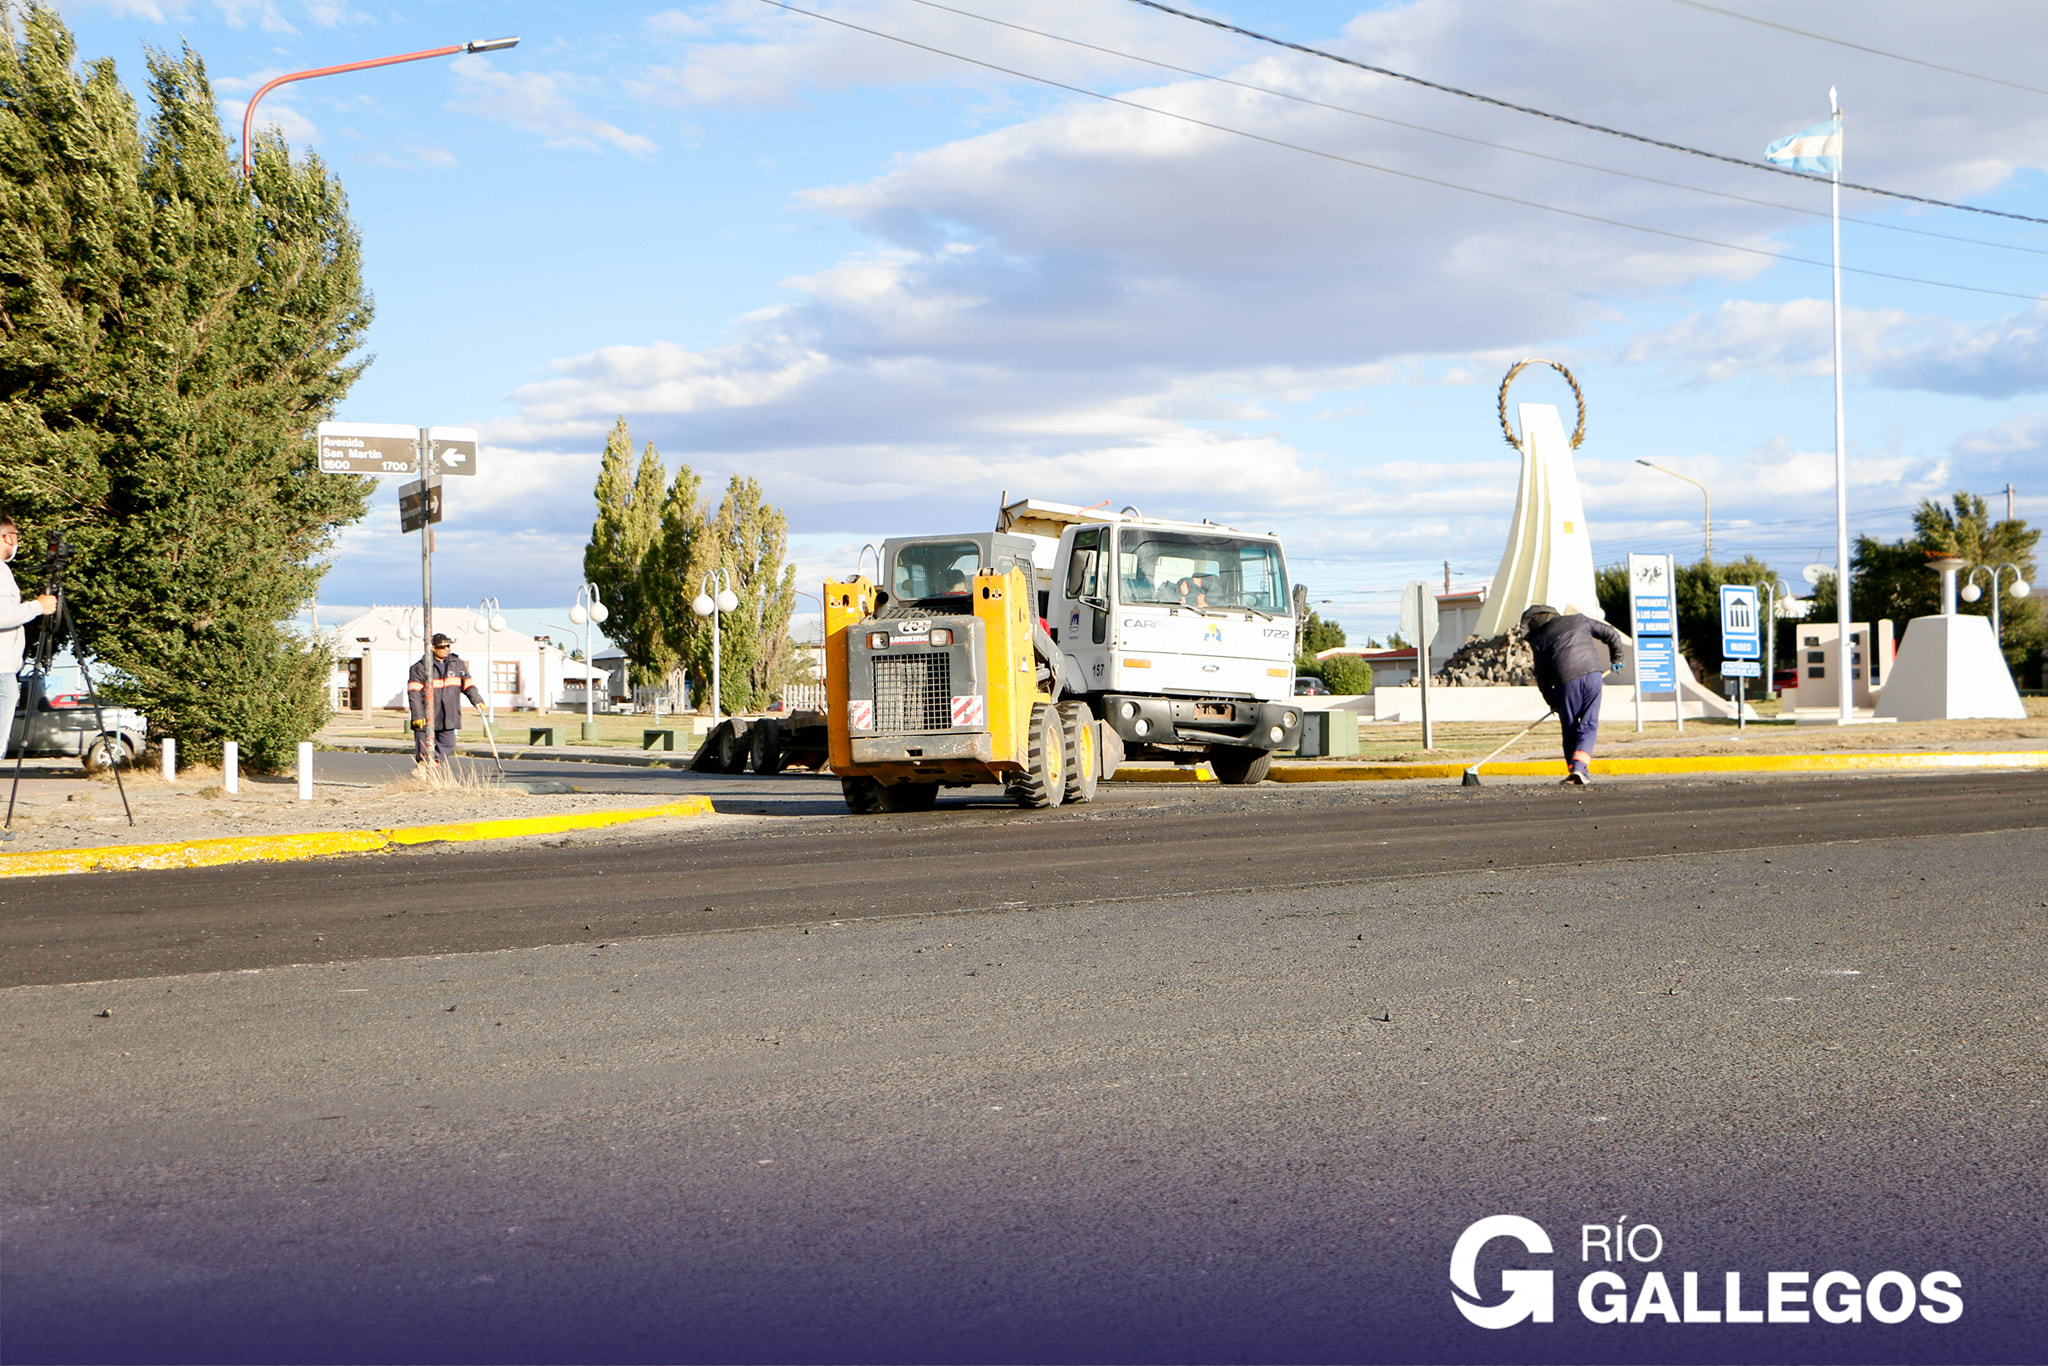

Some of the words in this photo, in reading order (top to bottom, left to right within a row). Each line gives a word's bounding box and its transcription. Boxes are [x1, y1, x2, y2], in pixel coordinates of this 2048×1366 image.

[323, 437, 364, 448] Avenida
[323, 448, 344, 458] San
[323, 460, 350, 470] 1600
[382, 461, 408, 472] 1700
[1263, 628, 1290, 640] 1722
[1730, 642, 1752, 652] MUSEO
[1092, 663, 1105, 677] 157
